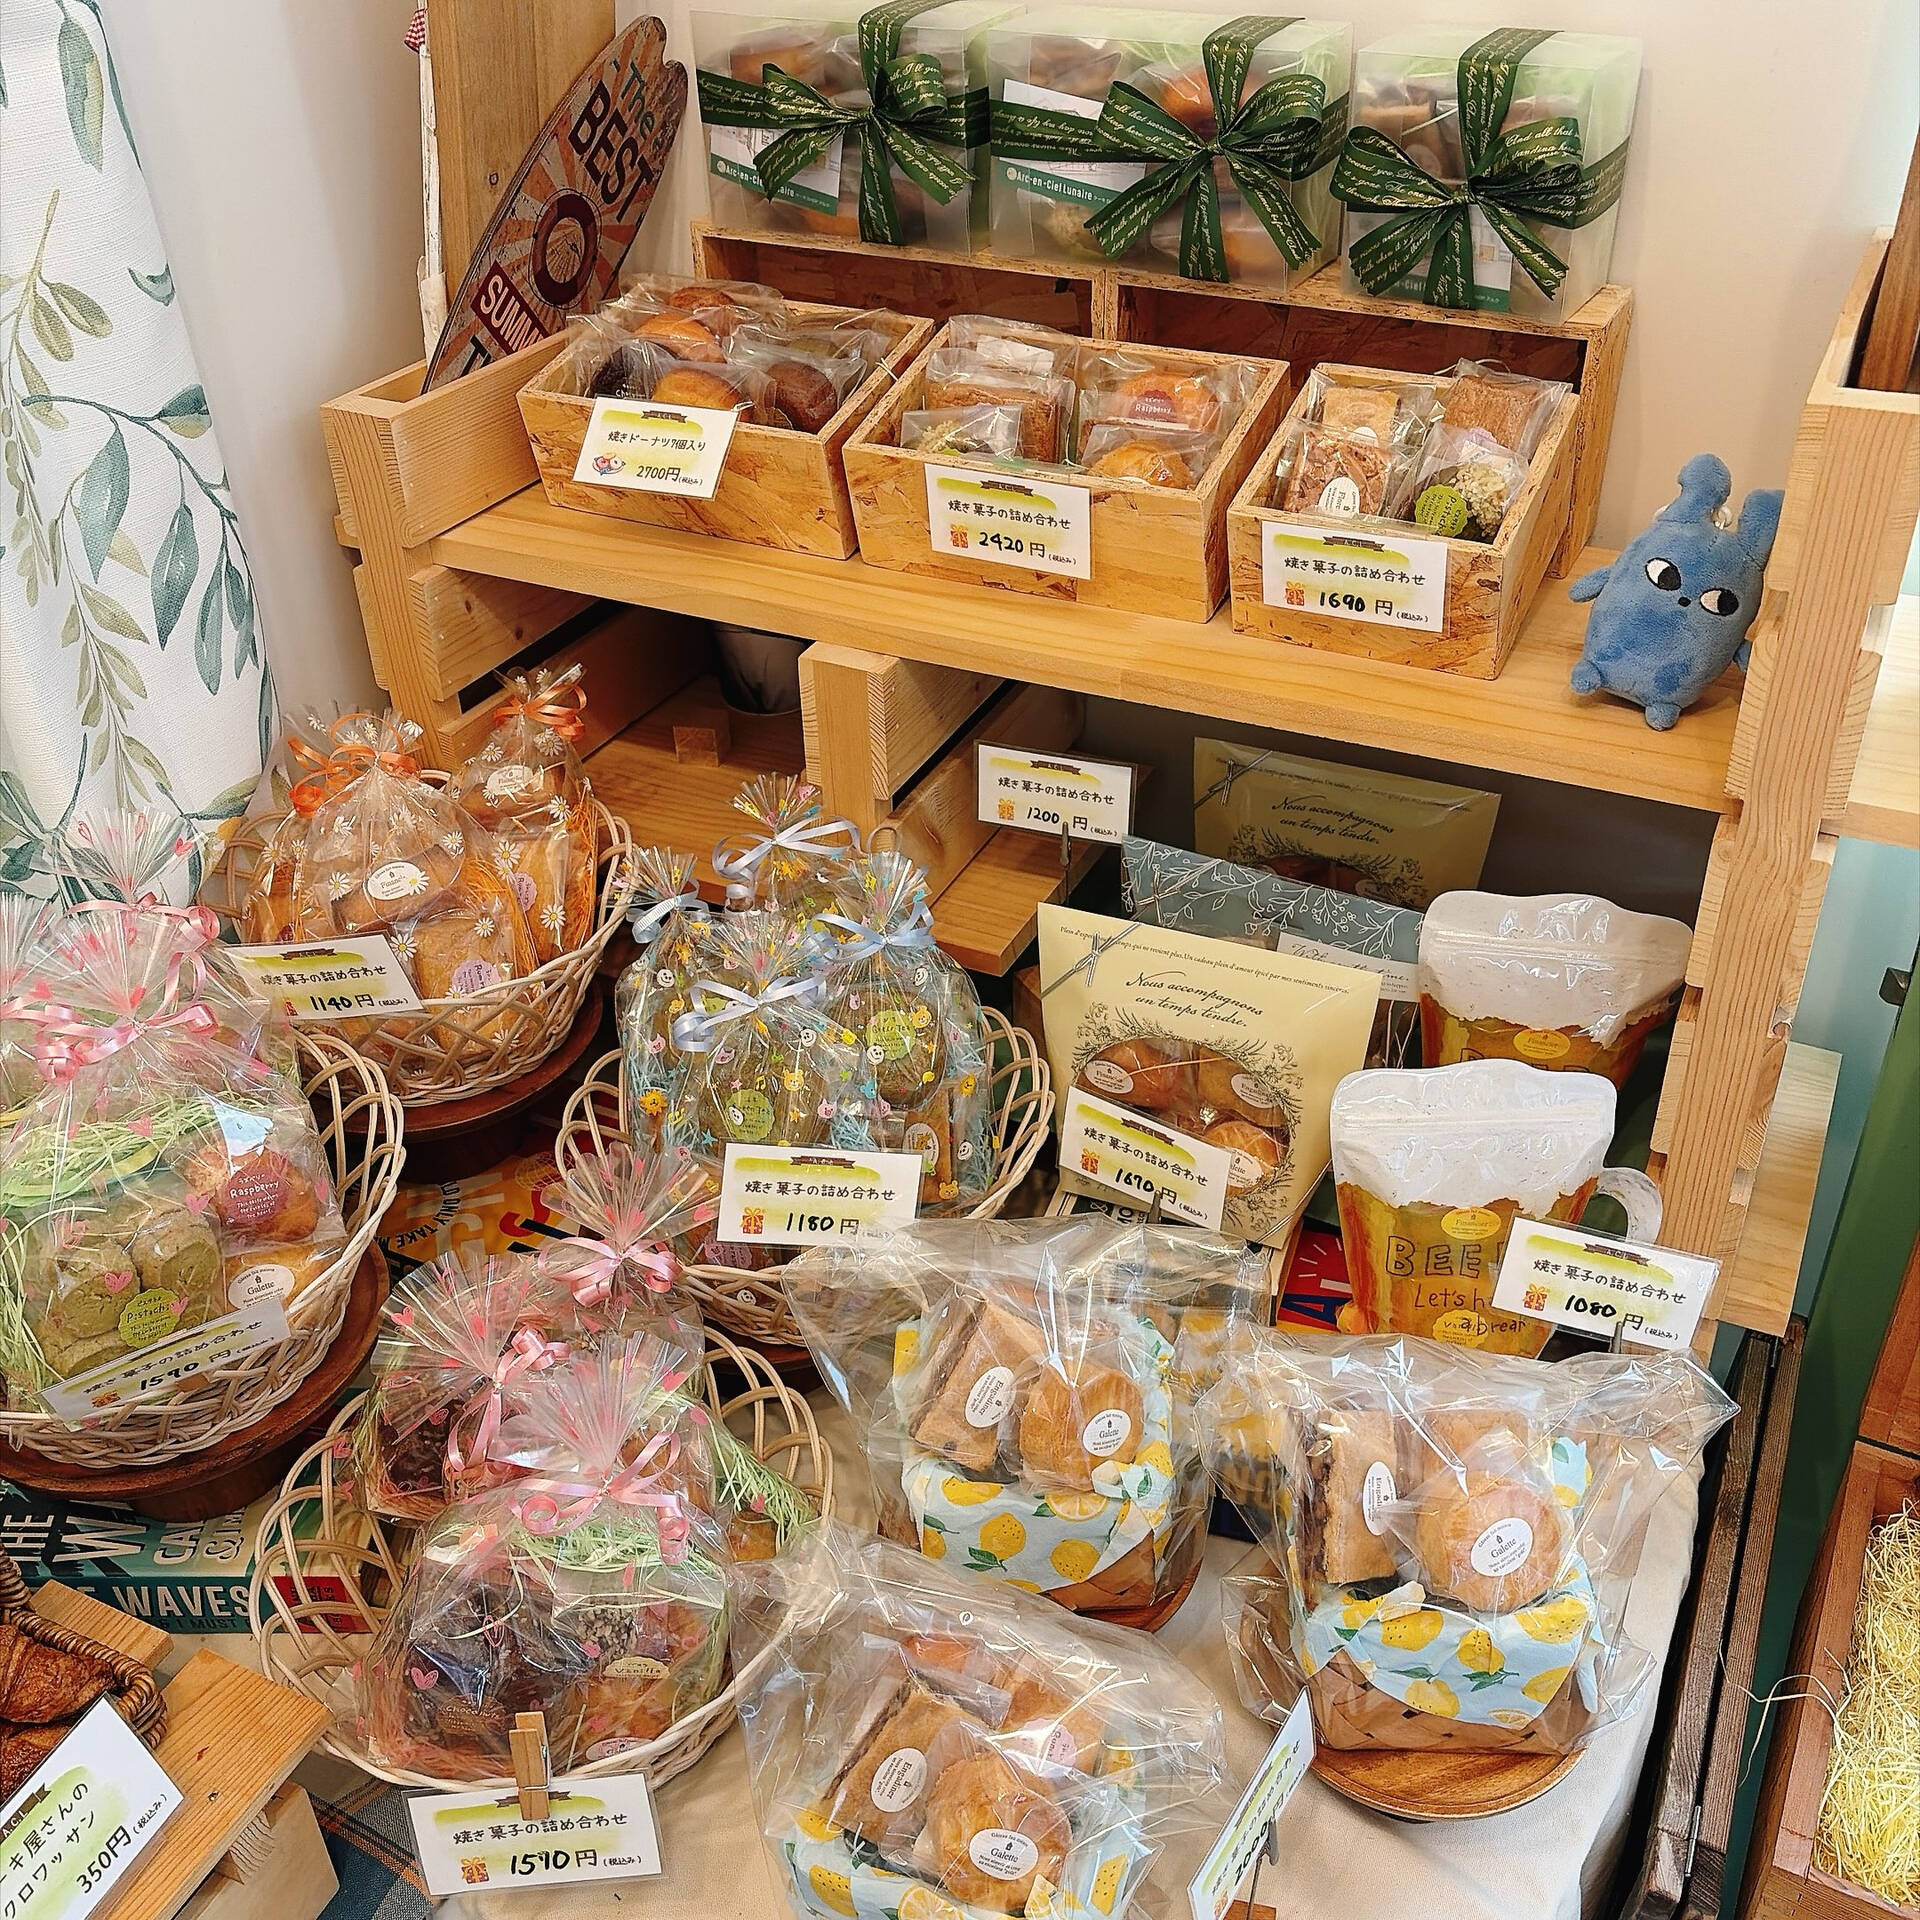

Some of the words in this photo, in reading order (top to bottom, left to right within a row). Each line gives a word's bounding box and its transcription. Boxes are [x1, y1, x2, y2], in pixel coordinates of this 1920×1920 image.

[568, 80, 655, 224] BEST
[1017, 169, 1062, 194] Arc-en-Ciel
[1062, 180, 1093, 201] Lunaire
[607, 430, 706, 452] 焼きドーナツ7個入り
[948, 500, 1072, 530] 焼き菓子の詰め合わせ
[979, 531, 1024, 554] 2420
[1029, 541, 1046, 558] 円
[1284, 556, 1426, 586] 焼き菓子の詰め合わせ
[1319, 591, 1367, 613] 1690
[1374, 599, 1393, 617] 円
[997, 777, 1116, 806] 焼き菓子の詰め合わせ
[1027, 806, 1060, 825] 1200
[1072, 815, 1089, 832] 円
[1272, 795, 1311, 813] Nous
[1308, 806, 1395, 835] accompagnons
[1280, 816, 1299, 827] un
[1300, 818, 1336, 838] temps
[260, 965, 389, 987] 焼き菓子の詰め合わせ
[310, 995, 353, 1012] 1140
[354, 993, 375, 1009] 円
[1126, 971, 1168, 988] Nous
[1167, 981, 1265, 1017] accompagnons
[1135, 995, 1155, 1006] un
[1157, 996, 1198, 1018] temps
[1083, 1126, 1209, 1188] 焼き菓子の詰め合わせ
[229, 1180, 279, 1199] Raspberry
[745, 1181, 896, 1202] 焼き菓子の詰め合わせ
[1160, 1186, 1178, 1206] 円
[397, 1223, 438, 1249] TAKE
[786, 1211, 835, 1233] 1180
[839, 1217, 860, 1236] 円
[1386, 1235, 1503, 1279] BEE
[247, 1280, 276, 1296] Galette
[1414, 1282, 1467, 1309] Let's
[1533, 1259, 1687, 1306] 焼き菓子の詰め合わせ
[1564, 1294, 1617, 1319] 1080
[1622, 1312, 1644, 1331] 円
[140, 1361, 200, 1391] 1590
[1490, 1537, 1518, 1560] Galette
[112, 1585, 250, 1617] WAVES
[453, 1814, 628, 1845] 焼き菓子の詰め合わせ
[76, 1825, 132, 1894] 350円
[132, 1793, 168, 1835] (税込み)
[990, 1847, 1020, 1863] Galette
[4, 1810, 95, 1919] クロワッサン
[575, 1848, 598, 1868] 円
[603, 1854, 642, 1867] (税込み)
